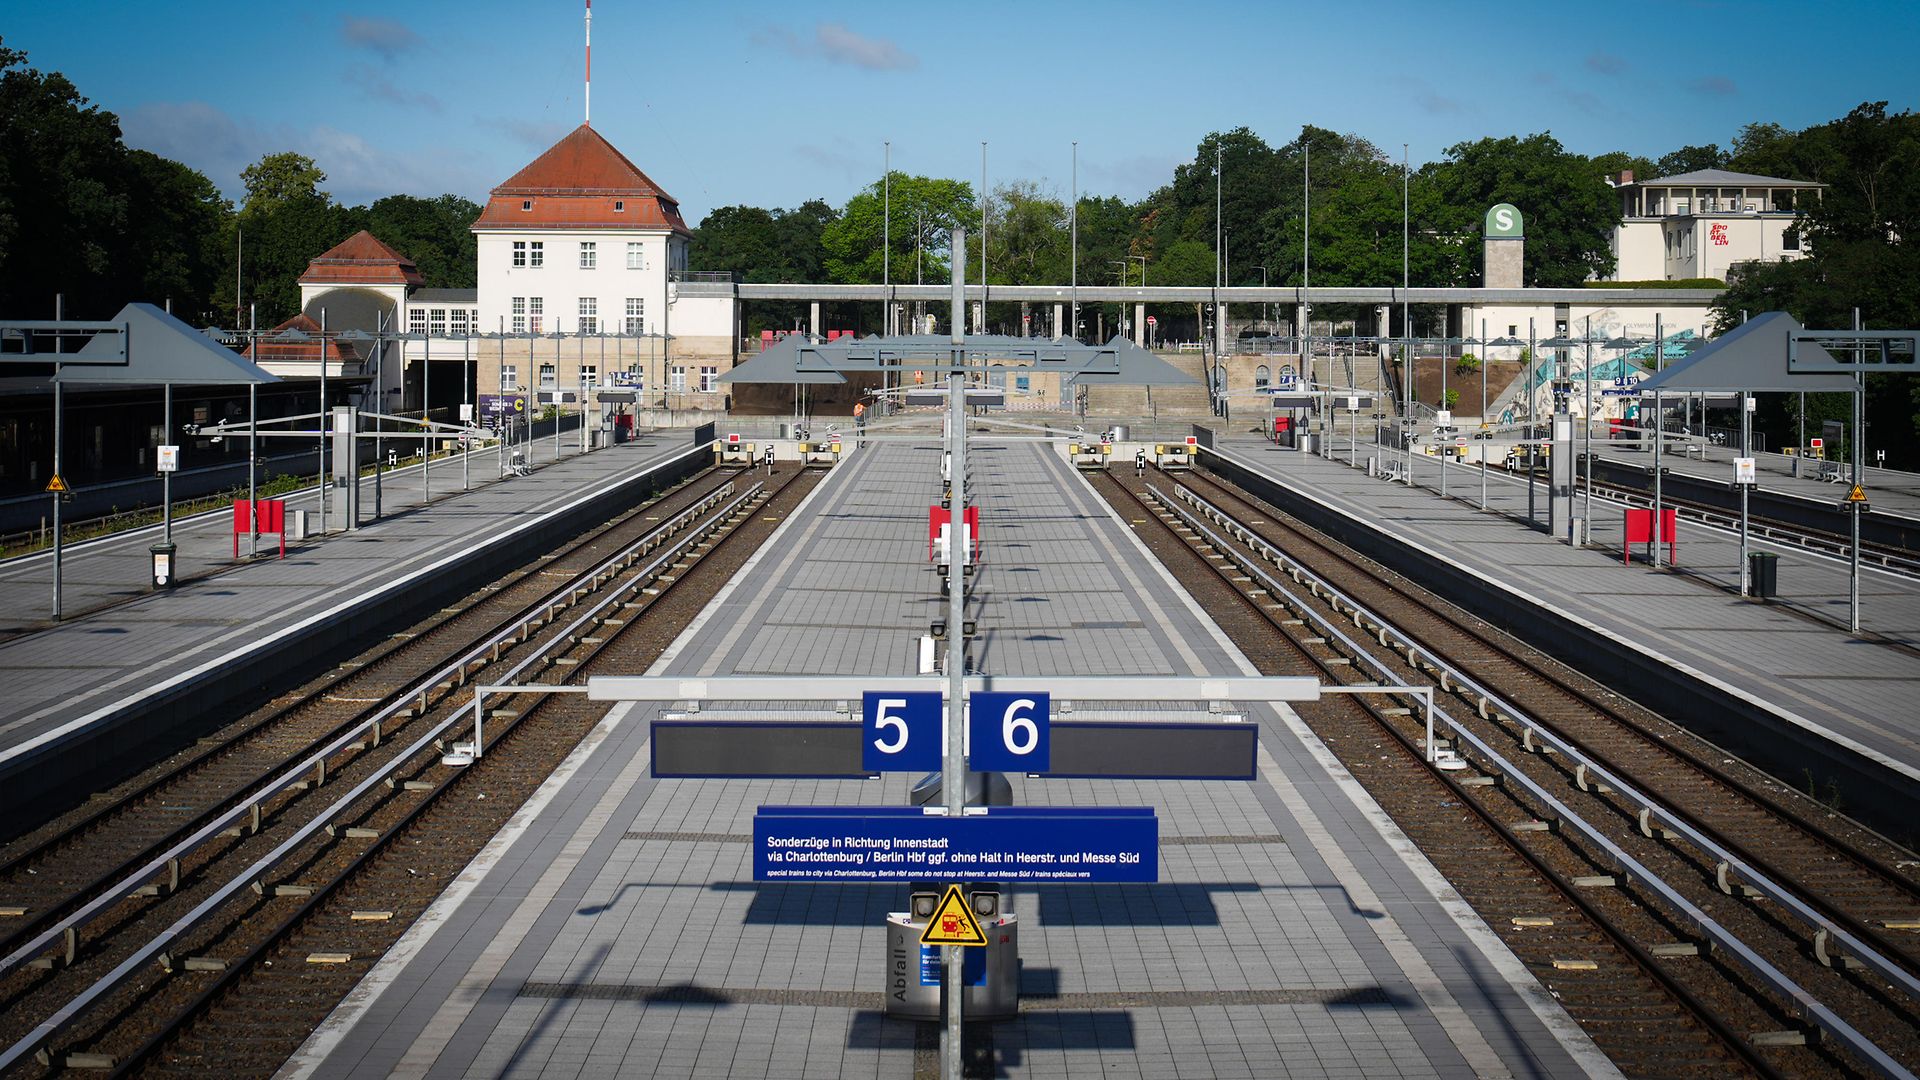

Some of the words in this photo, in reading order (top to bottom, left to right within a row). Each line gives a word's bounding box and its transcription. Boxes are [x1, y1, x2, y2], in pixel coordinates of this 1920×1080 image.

[1495, 208, 1513, 231] S
[1615, 377, 1621, 385] 9
[1629, 377, 1638, 385] 10
[416, 447, 423, 457] H
[1877, 449, 1885, 461] H
[389, 454, 397, 465] H
[765, 453, 774, 464] H
[1136, 457, 1145, 468] H
[1506, 458, 1515, 470] H
[874, 699, 909, 754] 5
[1003, 699, 1038, 755] 6
[767, 836, 829, 849] Sonderzüge
[832, 837, 842, 848] in
[844, 836, 891, 850] Richtung
[893, 837, 949, 848] Innenstadt
[767, 851, 783, 862] via
[785, 851, 863, 864] Charlottenburg
[866, 851, 871, 862] /
[873, 851, 904, 863] Berlin
[907, 851, 926, 863] Hbf
[928, 852, 948, 865] ggf.
[951, 852, 977, 863] ohne
[979, 852, 1002, 863] Halt
[1004, 852, 1014, 863] in
[1016, 852, 1057, 863] Heerstr.
[1060, 852, 1080, 863] und
[1082, 852, 1116, 863] Messe
[1119, 852, 1140, 863] Süd
[767, 869, 788, 877] special
[943, 870, 957, 878] stop
[1052, 870, 1077, 878] spéciaux
[893, 949, 906, 1002] Abfall
